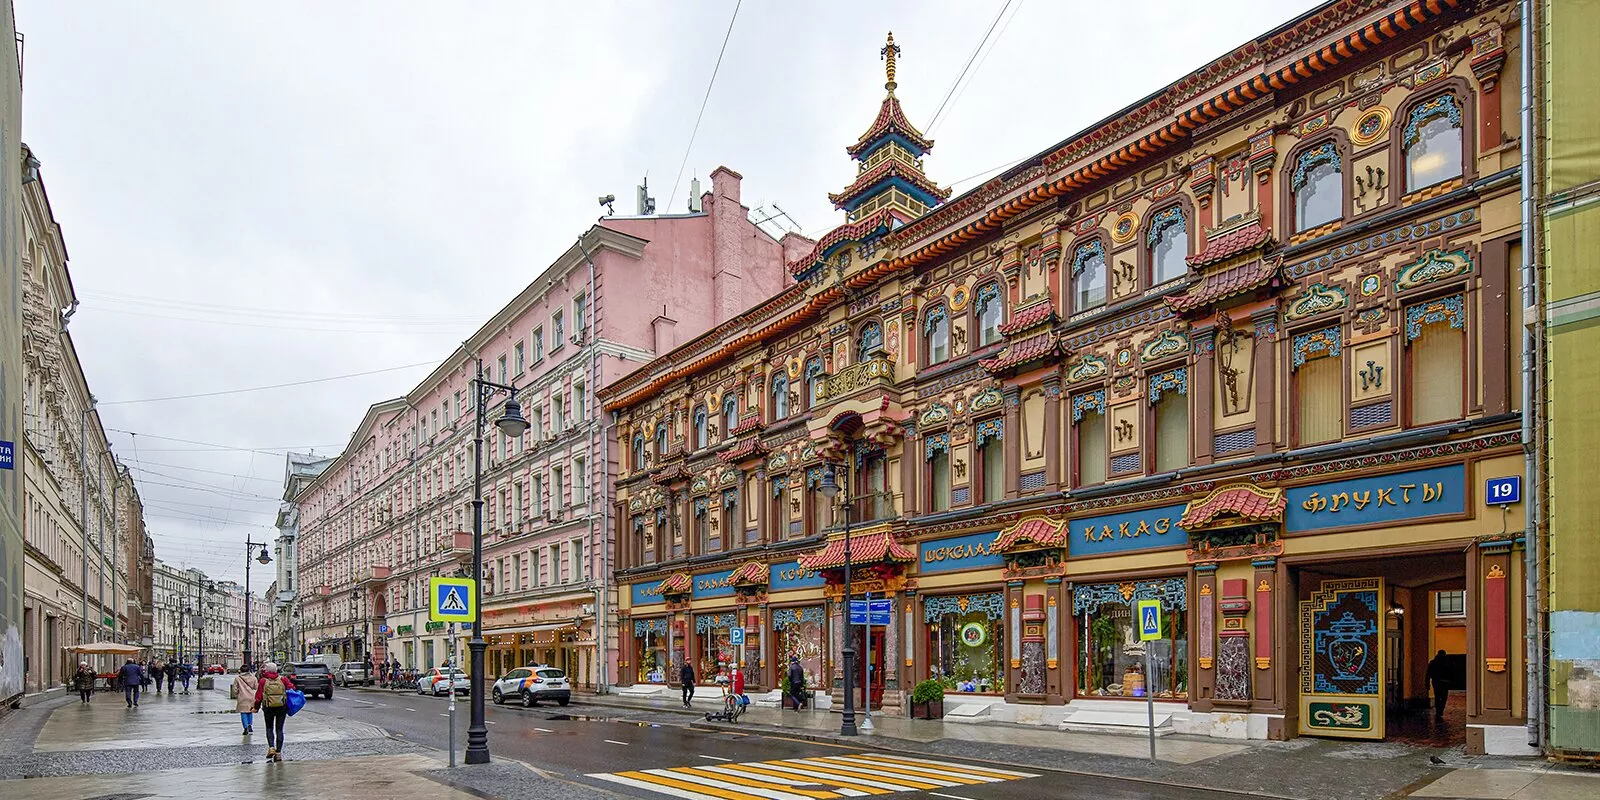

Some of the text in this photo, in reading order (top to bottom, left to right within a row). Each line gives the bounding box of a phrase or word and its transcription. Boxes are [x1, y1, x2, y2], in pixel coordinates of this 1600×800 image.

[1302, 482, 1443, 513] ФРУКТЫ
[1493, 483, 1512, 498] 19
[1085, 518, 1171, 543] КАКАО
